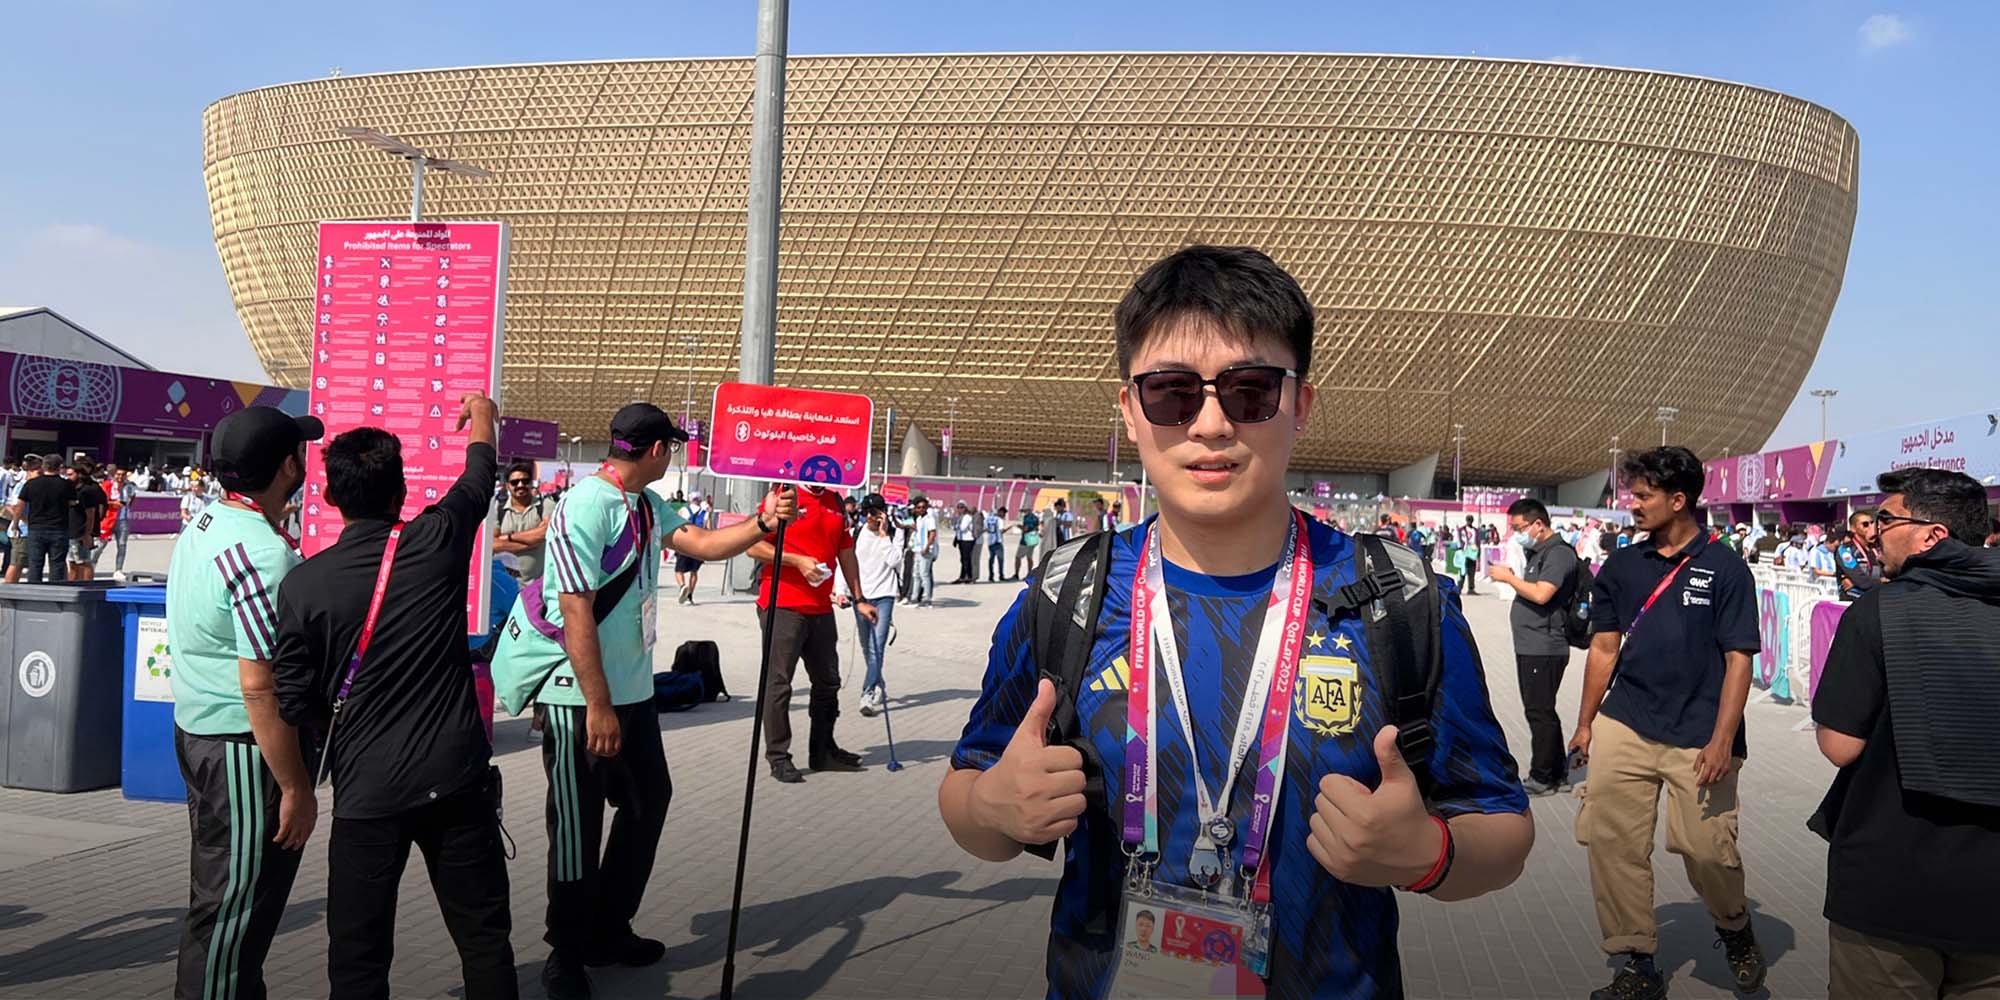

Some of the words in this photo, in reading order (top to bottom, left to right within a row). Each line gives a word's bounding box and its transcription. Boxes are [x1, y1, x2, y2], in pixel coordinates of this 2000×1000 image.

[343, 241, 386, 250] Prohibited
[387, 241, 411, 250] Items
[412, 242, 424, 250] for
[426, 242, 472, 251] Spectators
[761, 407, 774, 418] هيا
[775, 408, 802, 422] بطاقة
[816, 435, 837, 446] فعل
[1901, 429, 1929, 454] الجمهور
[1930, 426, 1955, 450] مدخل
[1928, 456, 1966, 470] Entrance
[1299, 543, 1308, 562] FIFA
[1296, 562, 1307, 596] WORLD
[1689, 577, 1710, 588] GWC
[1137, 589, 1146, 608] CUP
[1293, 597, 1303, 618] CUP
[1135, 610, 1146, 645] WORLD
[1135, 645, 1145, 669] FIFA
[1311, 676, 1346, 712] AFA
